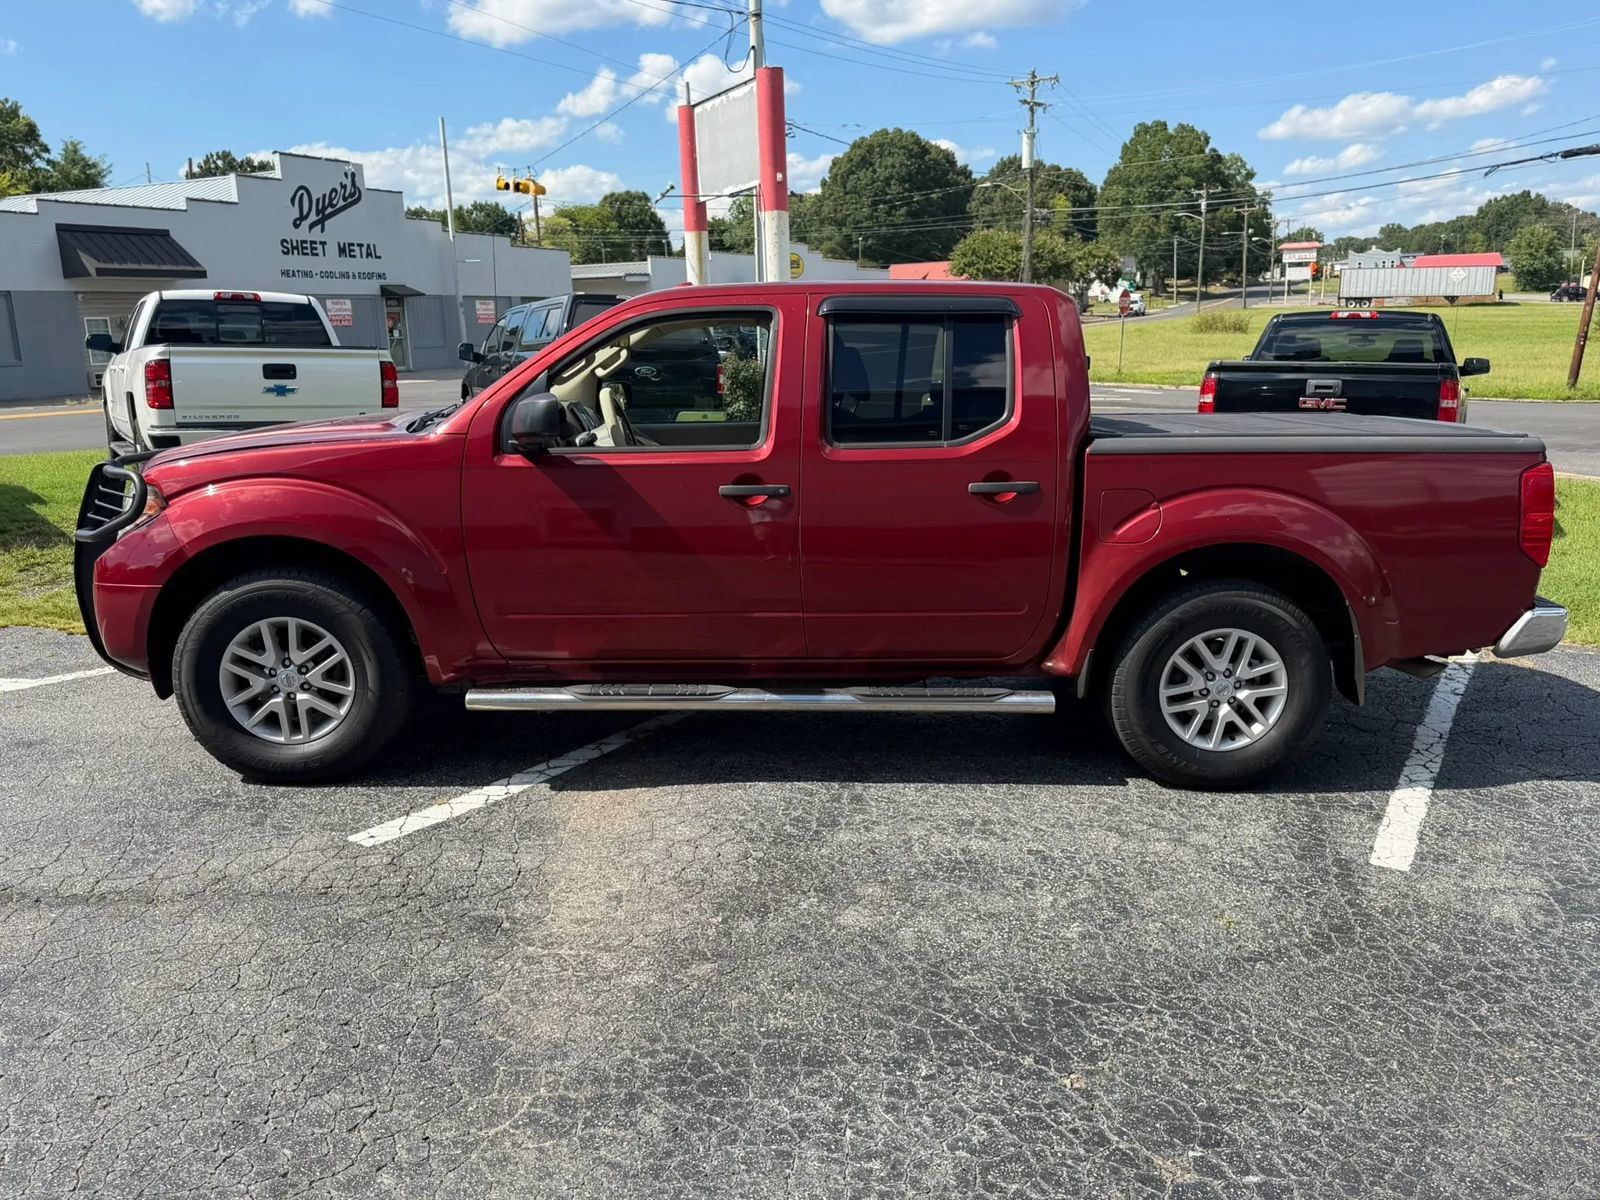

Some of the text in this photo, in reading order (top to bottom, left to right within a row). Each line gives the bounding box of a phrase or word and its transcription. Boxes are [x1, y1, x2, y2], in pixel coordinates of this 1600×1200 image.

[290, 171, 362, 233] Dyer's
[280, 238, 382, 259] SHEET METAL
[280, 268, 314, 279] HEATING
[319, 270, 350, 280] COOLING
[357, 271, 387, 281] ROOFING
[1299, 397, 1347, 410] GMC
